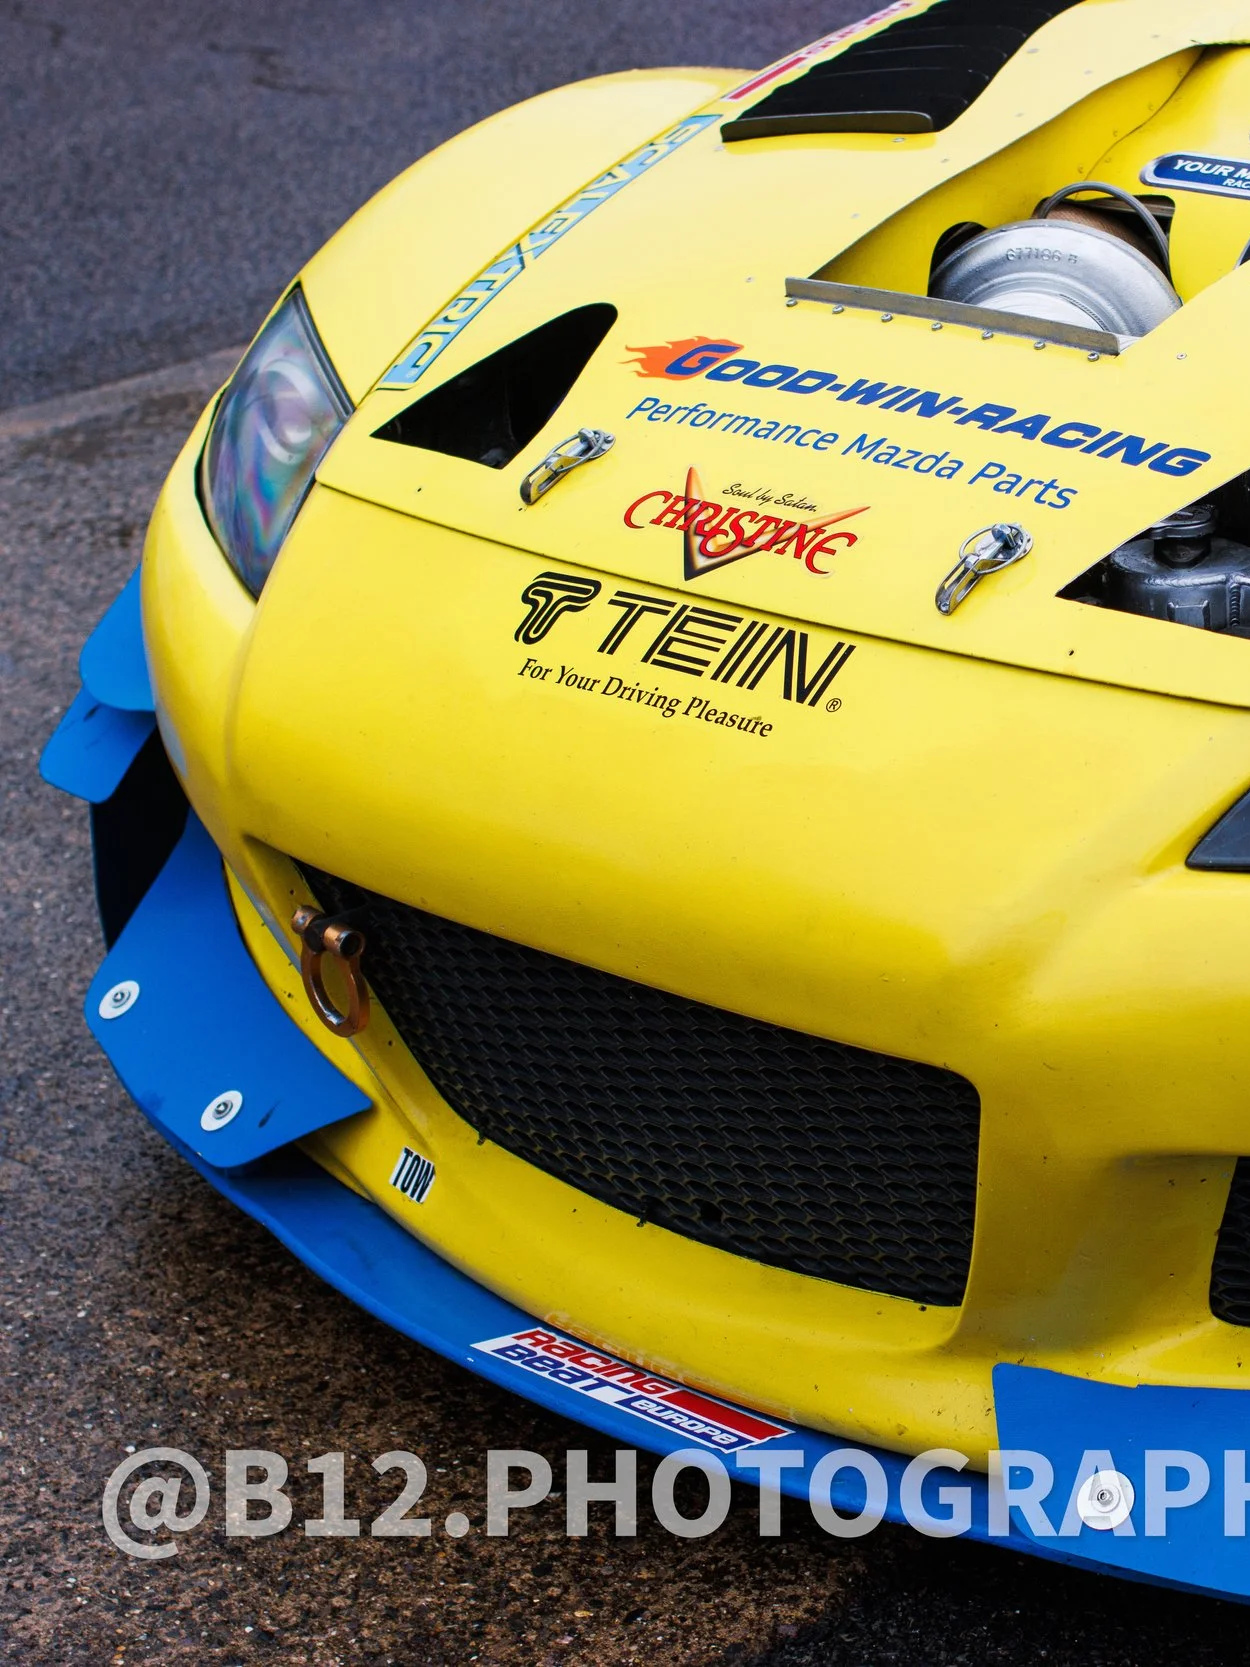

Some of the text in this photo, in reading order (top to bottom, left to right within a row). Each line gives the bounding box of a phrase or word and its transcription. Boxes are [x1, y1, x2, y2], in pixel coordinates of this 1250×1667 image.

[1172, 159, 1230, 178] YOUR
[664, 343, 1212, 477] GOOD-WIN-RACING
[625, 396, 1079, 510] Performance Mazda Parts
[623, 490, 858, 575] CHRISTINE
[722, 483, 756, 500] Soul
[757, 488, 775, 507] by
[597, 590, 857, 708] TEIN
[517, 657, 774, 738] For Your Driving Pleasure
[392, 1147, 437, 1203] TOW
